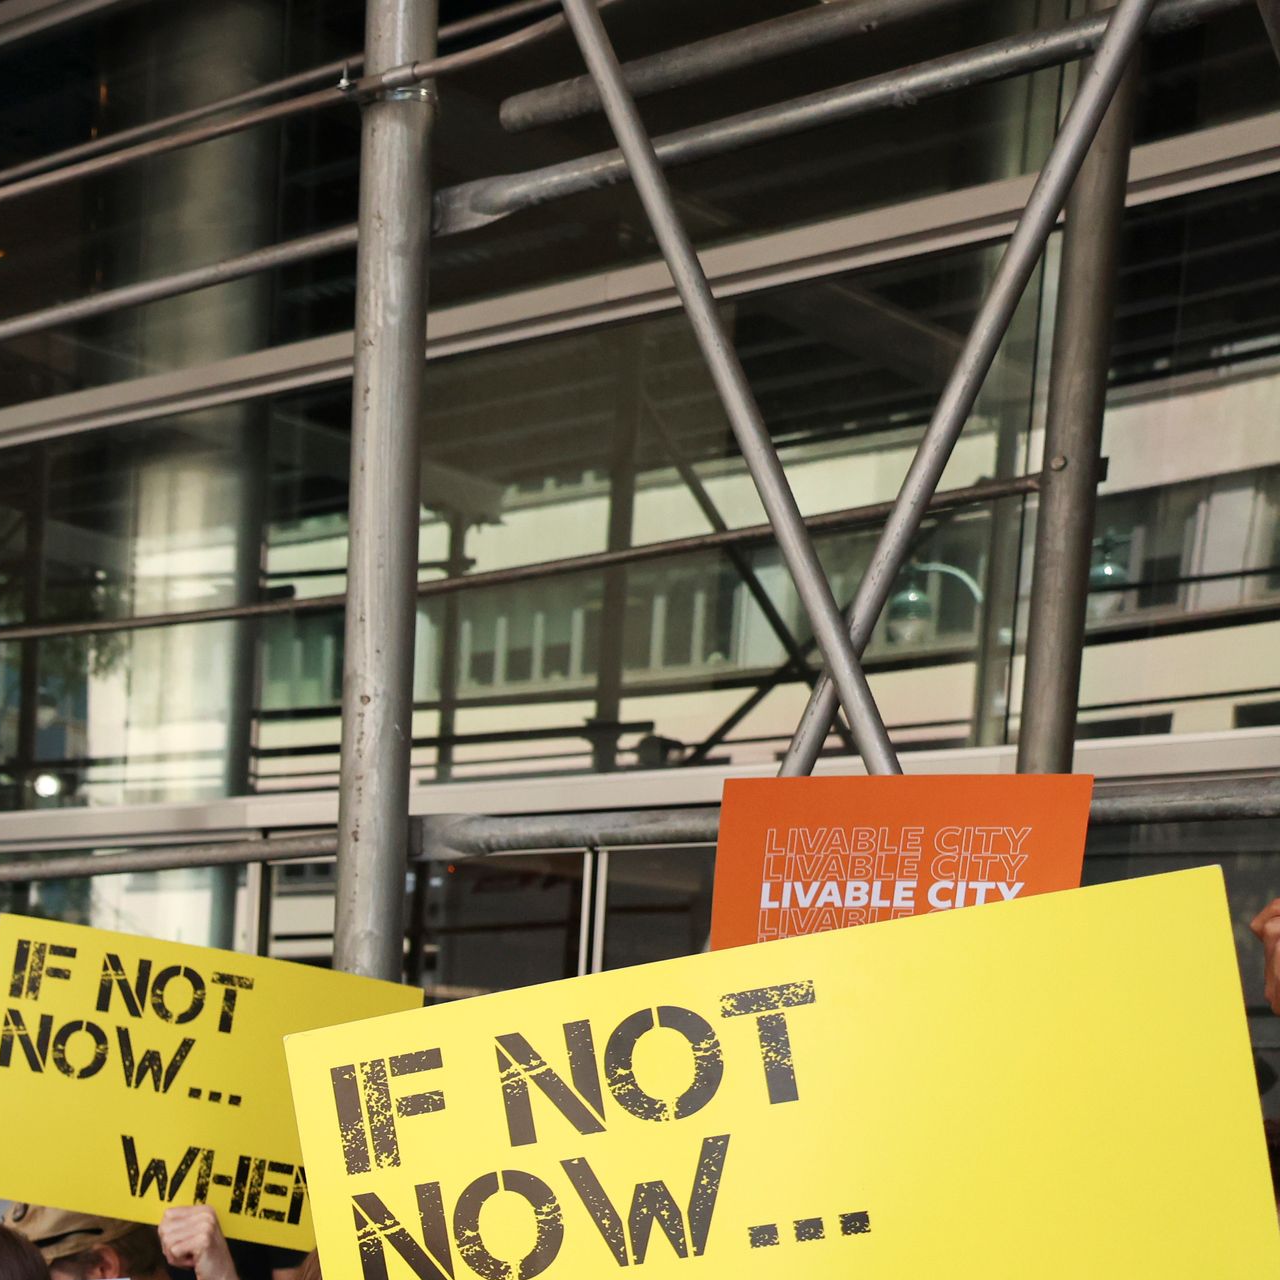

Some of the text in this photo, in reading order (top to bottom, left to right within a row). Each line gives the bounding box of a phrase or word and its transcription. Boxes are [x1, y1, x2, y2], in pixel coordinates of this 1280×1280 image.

[765, 826, 1032, 856] LIVABLE CITY
[762, 853, 1028, 882] LIVABLE CITY
[759, 879, 1025, 910] LIVABLE CITY
[8, 938, 255, 1034] IF NOT
[329, 978, 815, 1176] IF NOT
